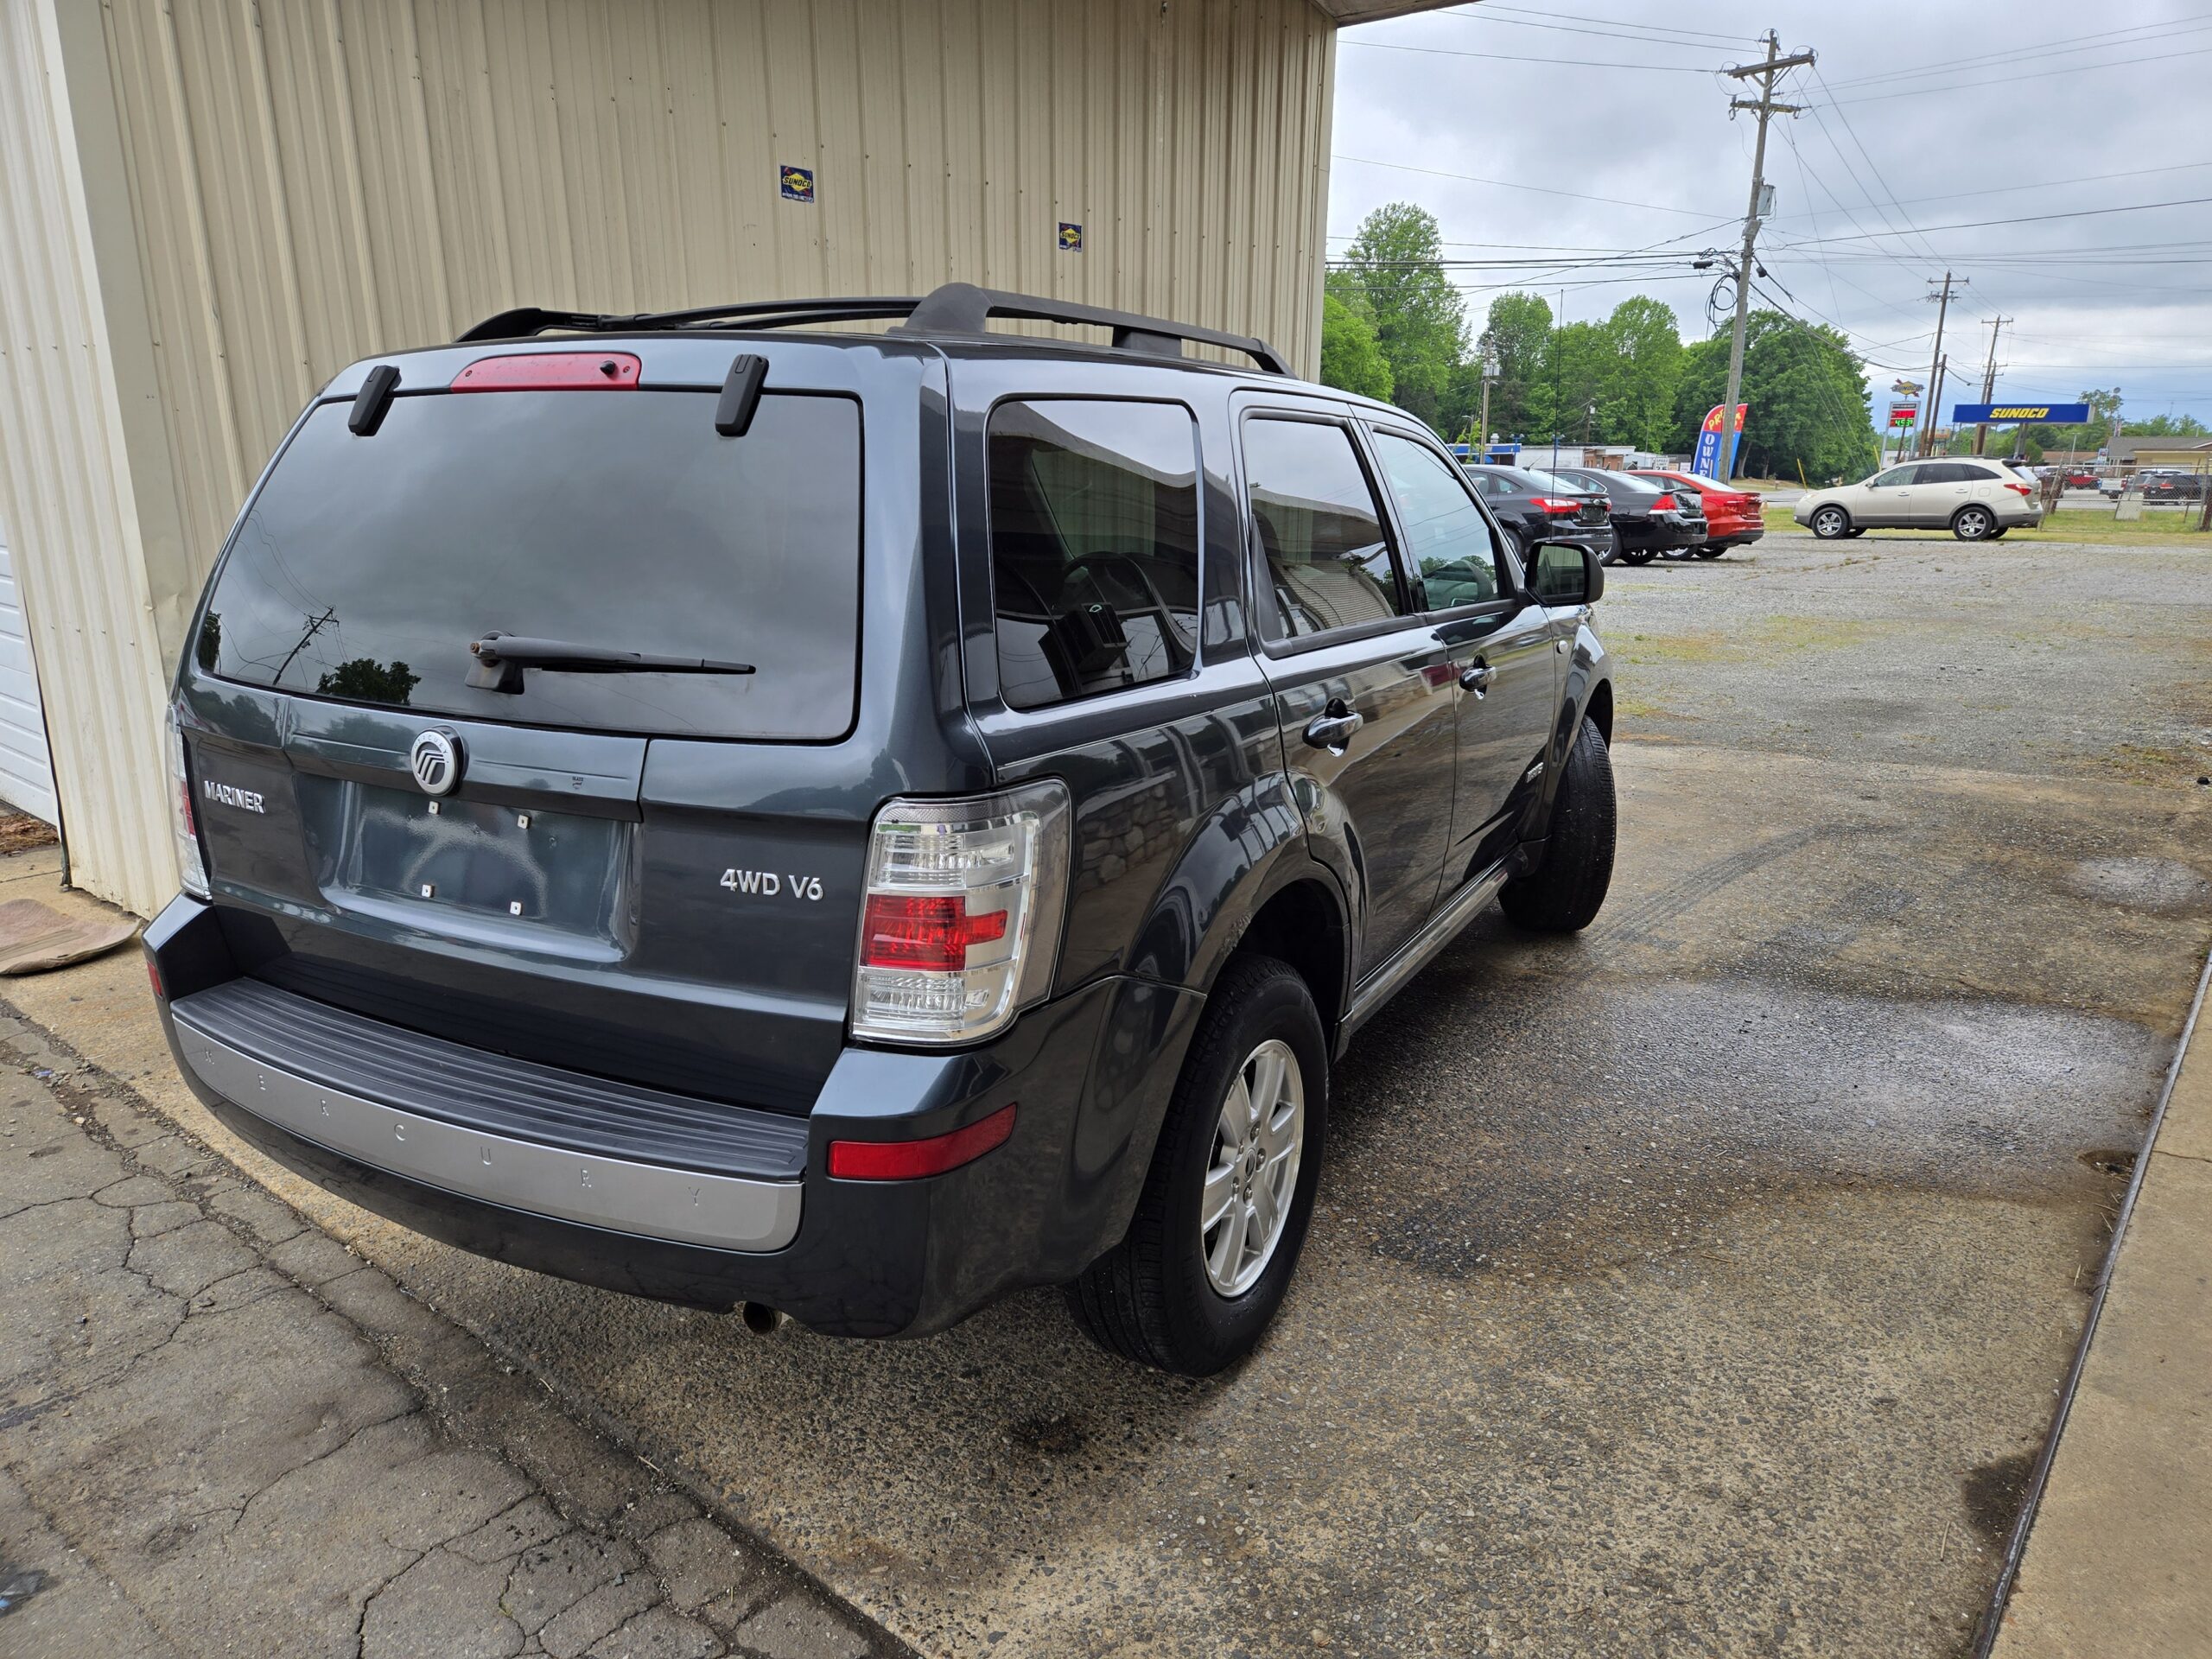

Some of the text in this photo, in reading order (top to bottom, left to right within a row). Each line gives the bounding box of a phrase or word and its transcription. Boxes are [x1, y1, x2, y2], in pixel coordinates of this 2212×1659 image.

[784, 176, 811, 188] SUNOCO
[1989, 408, 2050, 418] SUNOCO
[204, 780, 264, 814] MARINER
[720, 868, 823, 900] 4WD V6
[204, 1047, 701, 1206] MERCURY
